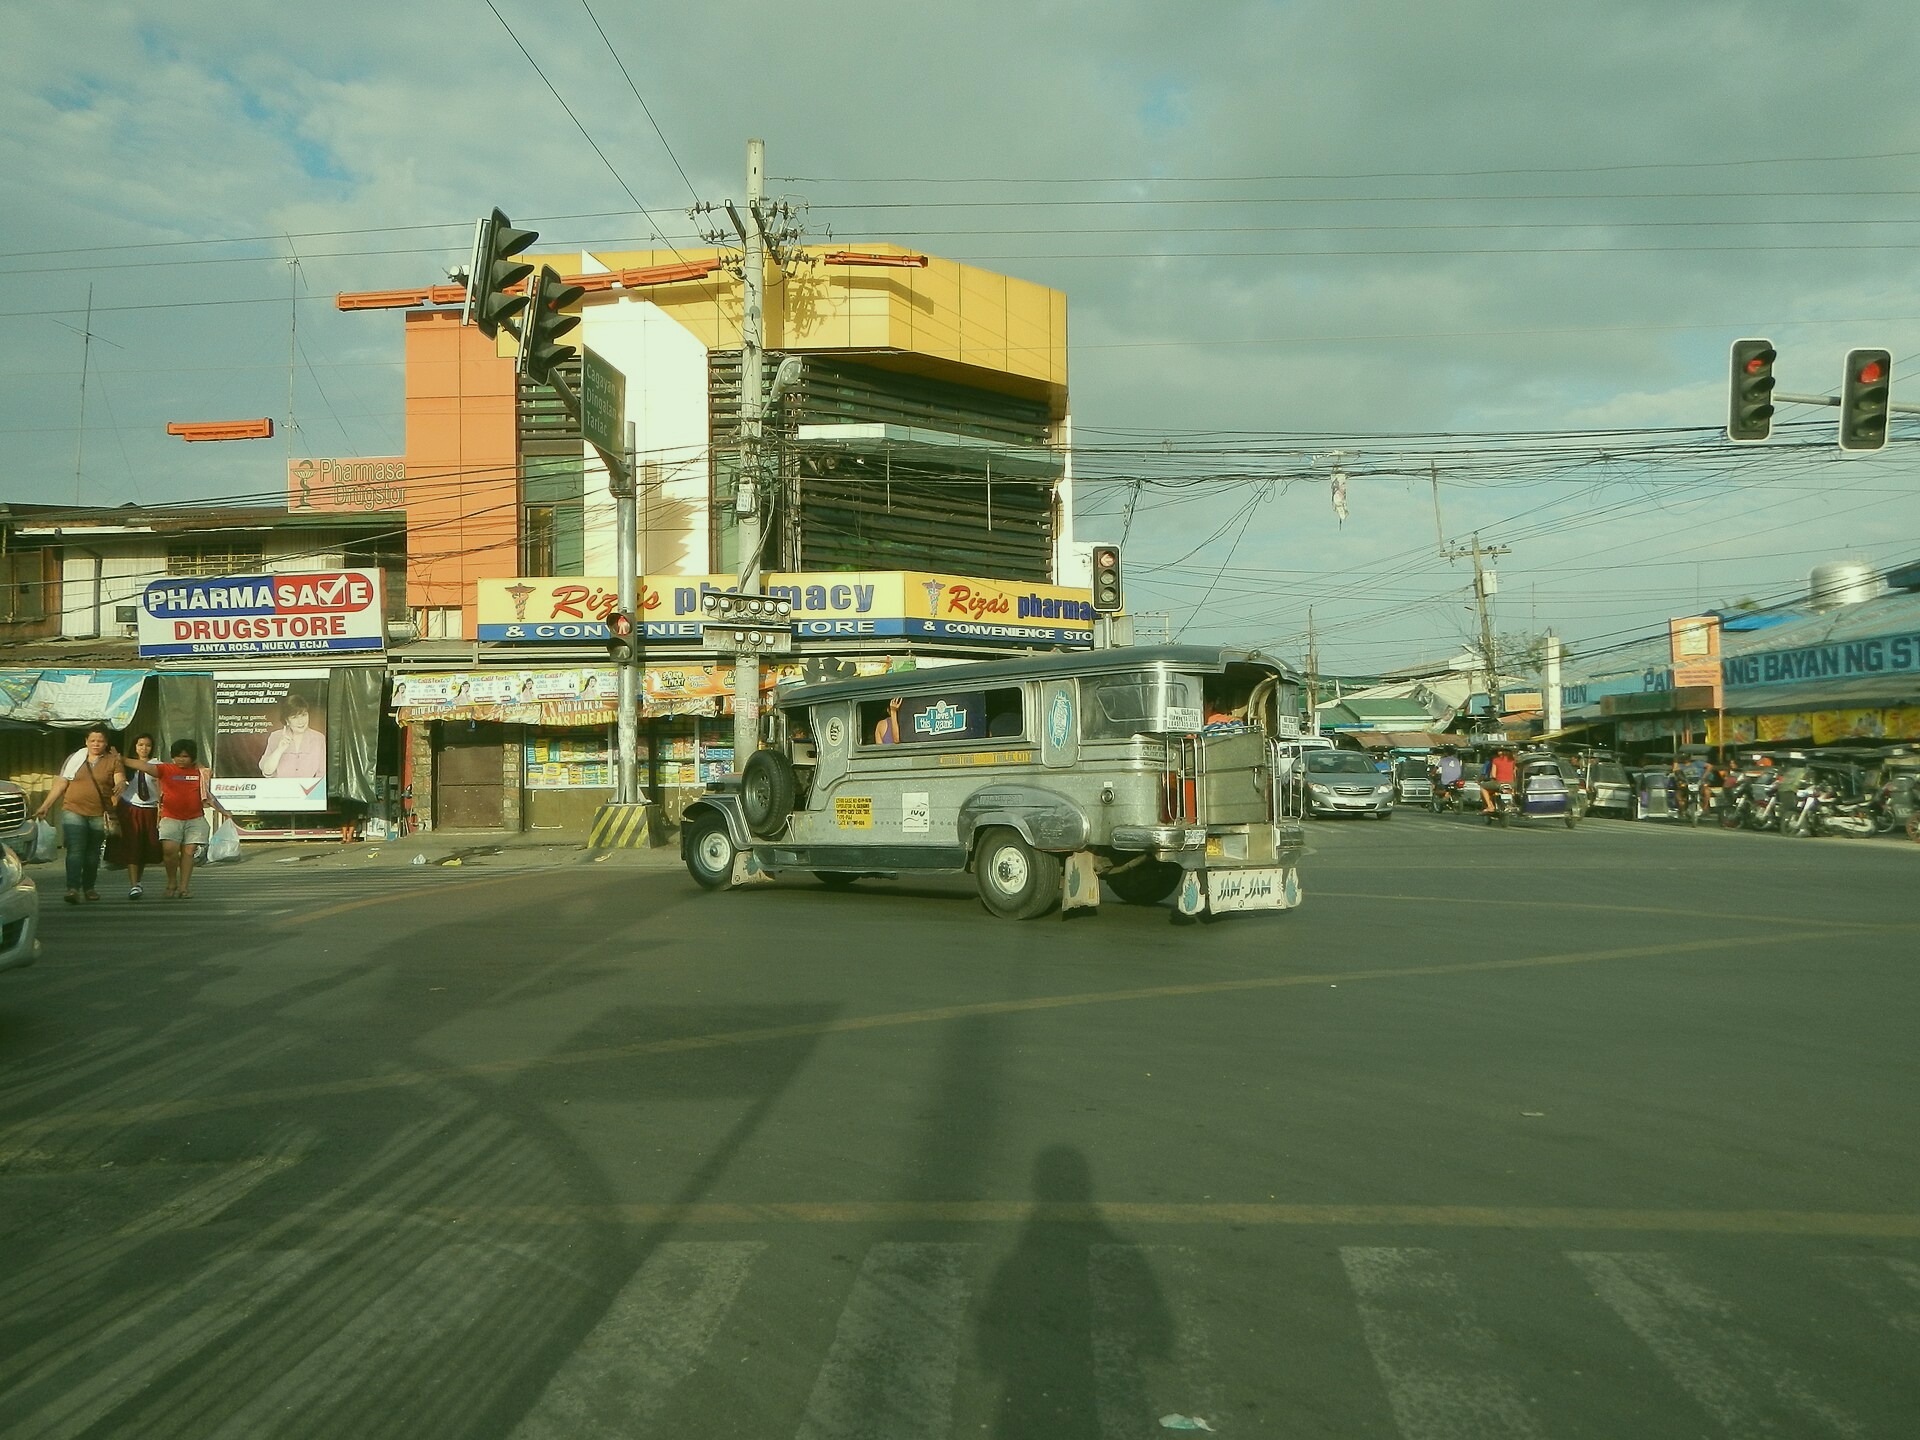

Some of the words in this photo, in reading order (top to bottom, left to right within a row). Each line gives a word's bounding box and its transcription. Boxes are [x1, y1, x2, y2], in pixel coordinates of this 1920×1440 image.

[586, 363, 616, 397] Cagayan
[586, 387, 618, 420] Dingalan
[586, 410, 608, 437] Tarlac
[550, 585, 661, 620] Riz's
[948, 585, 1009, 620] Riza's
[174, 616, 347, 640] DRUGSTORE
[505, 625, 526, 638] &
[923, 621, 936, 631] &
[945, 623, 1056, 639] CONVENIENCE
[192, 643, 226, 653] SANTA
[228, 642, 260, 652] ROSA,
[262, 641, 296, 651] NUEVA
[299, 640, 329, 650] ECIJA
[1763, 647, 1839, 682] BAYAN
[1844, 641, 1884, 673] NG
[248, 681, 290, 689] mahiyang
[215, 783, 257, 791] RiteMED
